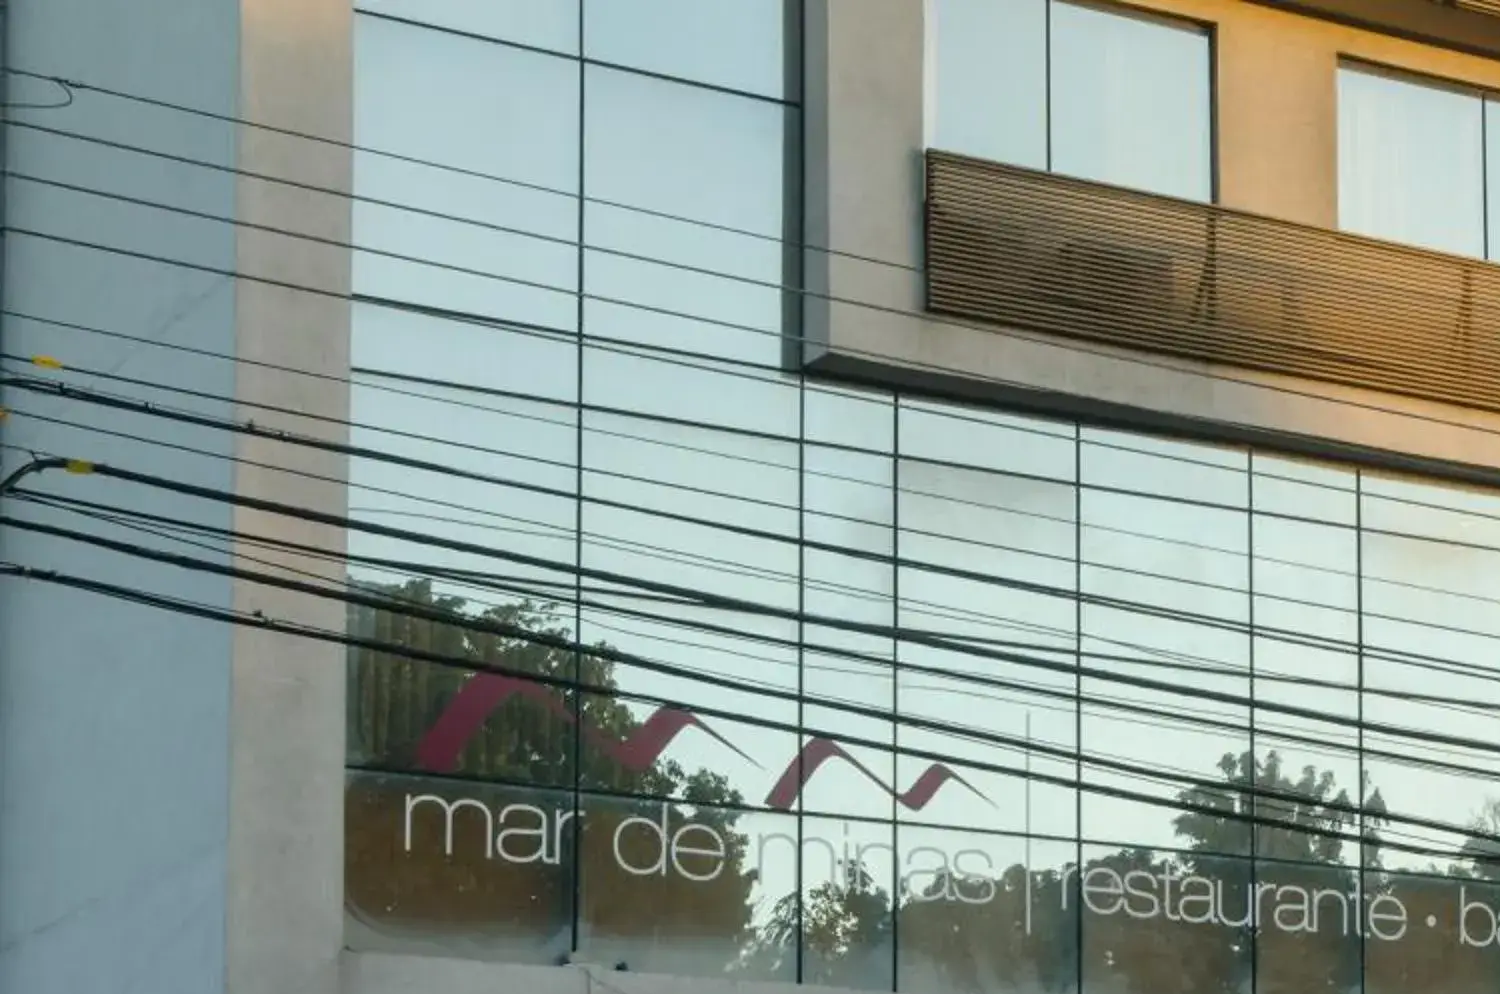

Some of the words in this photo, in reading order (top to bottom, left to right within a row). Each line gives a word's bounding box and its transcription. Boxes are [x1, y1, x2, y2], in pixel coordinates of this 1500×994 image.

[403, 793, 586, 865] mar
[612, 803, 726, 882] de
[756, 821, 995, 905] minas
[1061, 858, 1408, 942] restaurante
